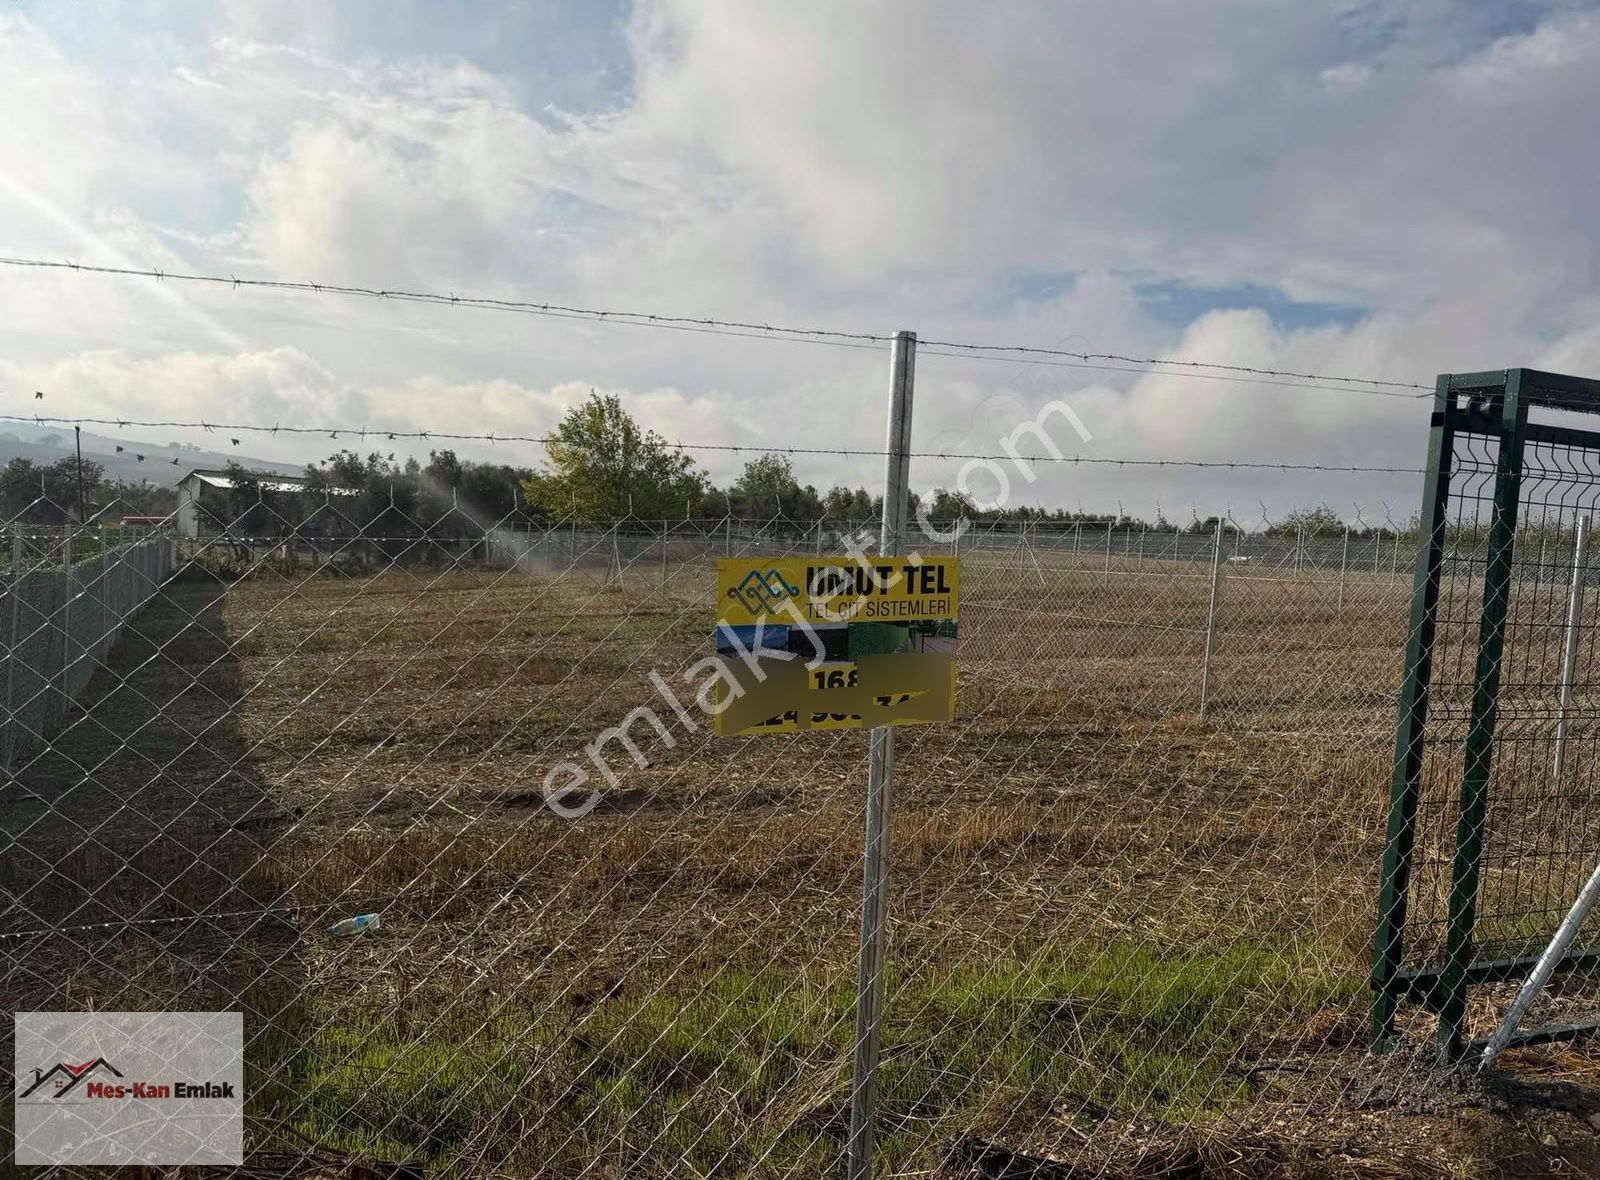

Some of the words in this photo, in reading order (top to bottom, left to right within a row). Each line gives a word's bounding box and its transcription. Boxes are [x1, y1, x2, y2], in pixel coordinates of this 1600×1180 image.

[806, 565, 893, 597] UMUT
[903, 565, 950, 594] TEL
[807, 602, 832, 618] TEL
[866, 597, 950, 616] SİSTEMLERİ
